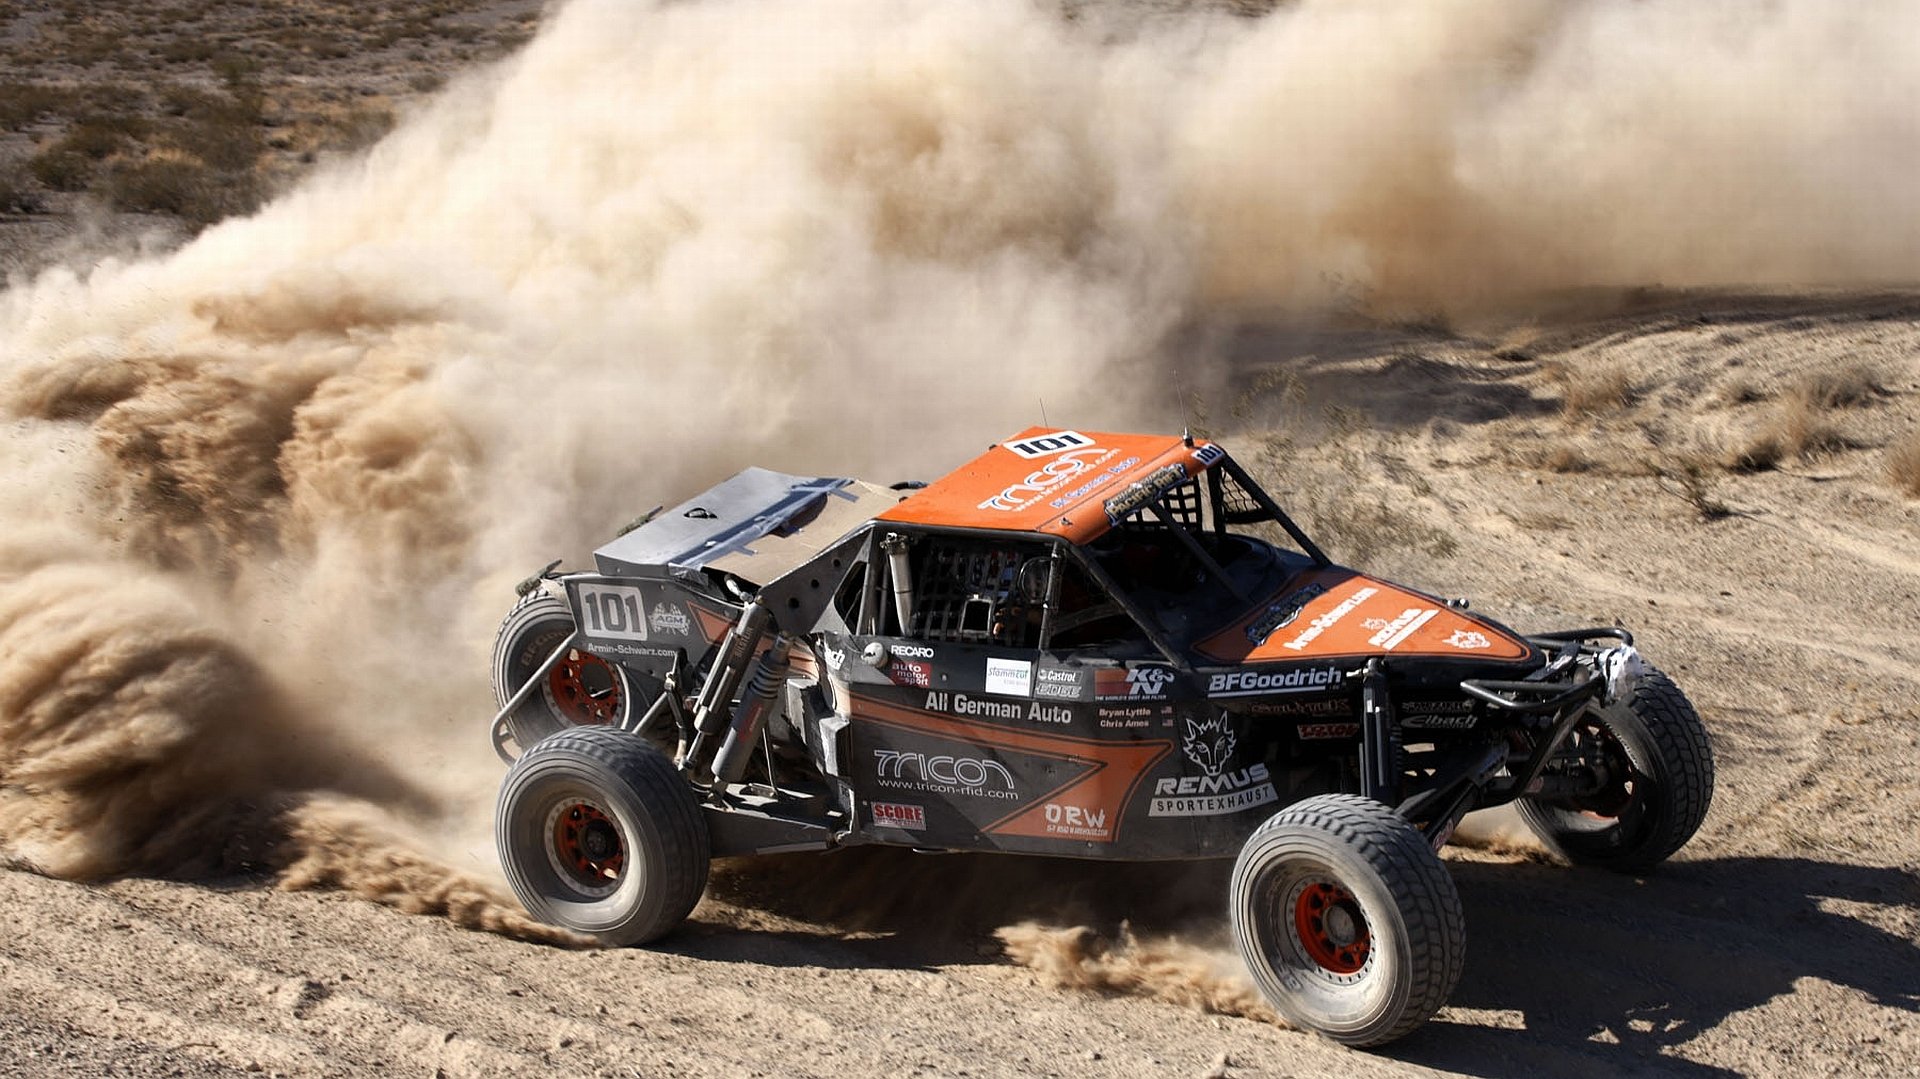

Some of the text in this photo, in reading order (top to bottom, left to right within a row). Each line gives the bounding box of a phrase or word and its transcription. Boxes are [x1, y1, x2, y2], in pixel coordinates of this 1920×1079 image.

[1013, 434, 1084, 455] 101
[1196, 445, 1222, 463] 101
[585, 591, 642, 633] 101
[657, 614, 684, 624] AGM
[588, 642, 678, 658] Armin-Schwarz.com
[891, 645, 935, 658] RECARO
[892, 662, 922, 673] auto
[1047, 670, 1076, 682] Castrol
[904, 677, 928, 686] sport
[1209, 667, 1342, 691] BFGoodrich
[925, 691, 1072, 724] All German Auto
[1099, 707, 1151, 718] Bryan Lyttle
[1100, 719, 1123, 728] Chris
[1154, 762, 1269, 796] REMUS
[878, 778, 1019, 800] www.tricon-rfid.com
[1157, 786, 1270, 812] SPORTEXHAUST
[874, 804, 923, 821] SCORE
[1044, 803, 1106, 828] ORW
